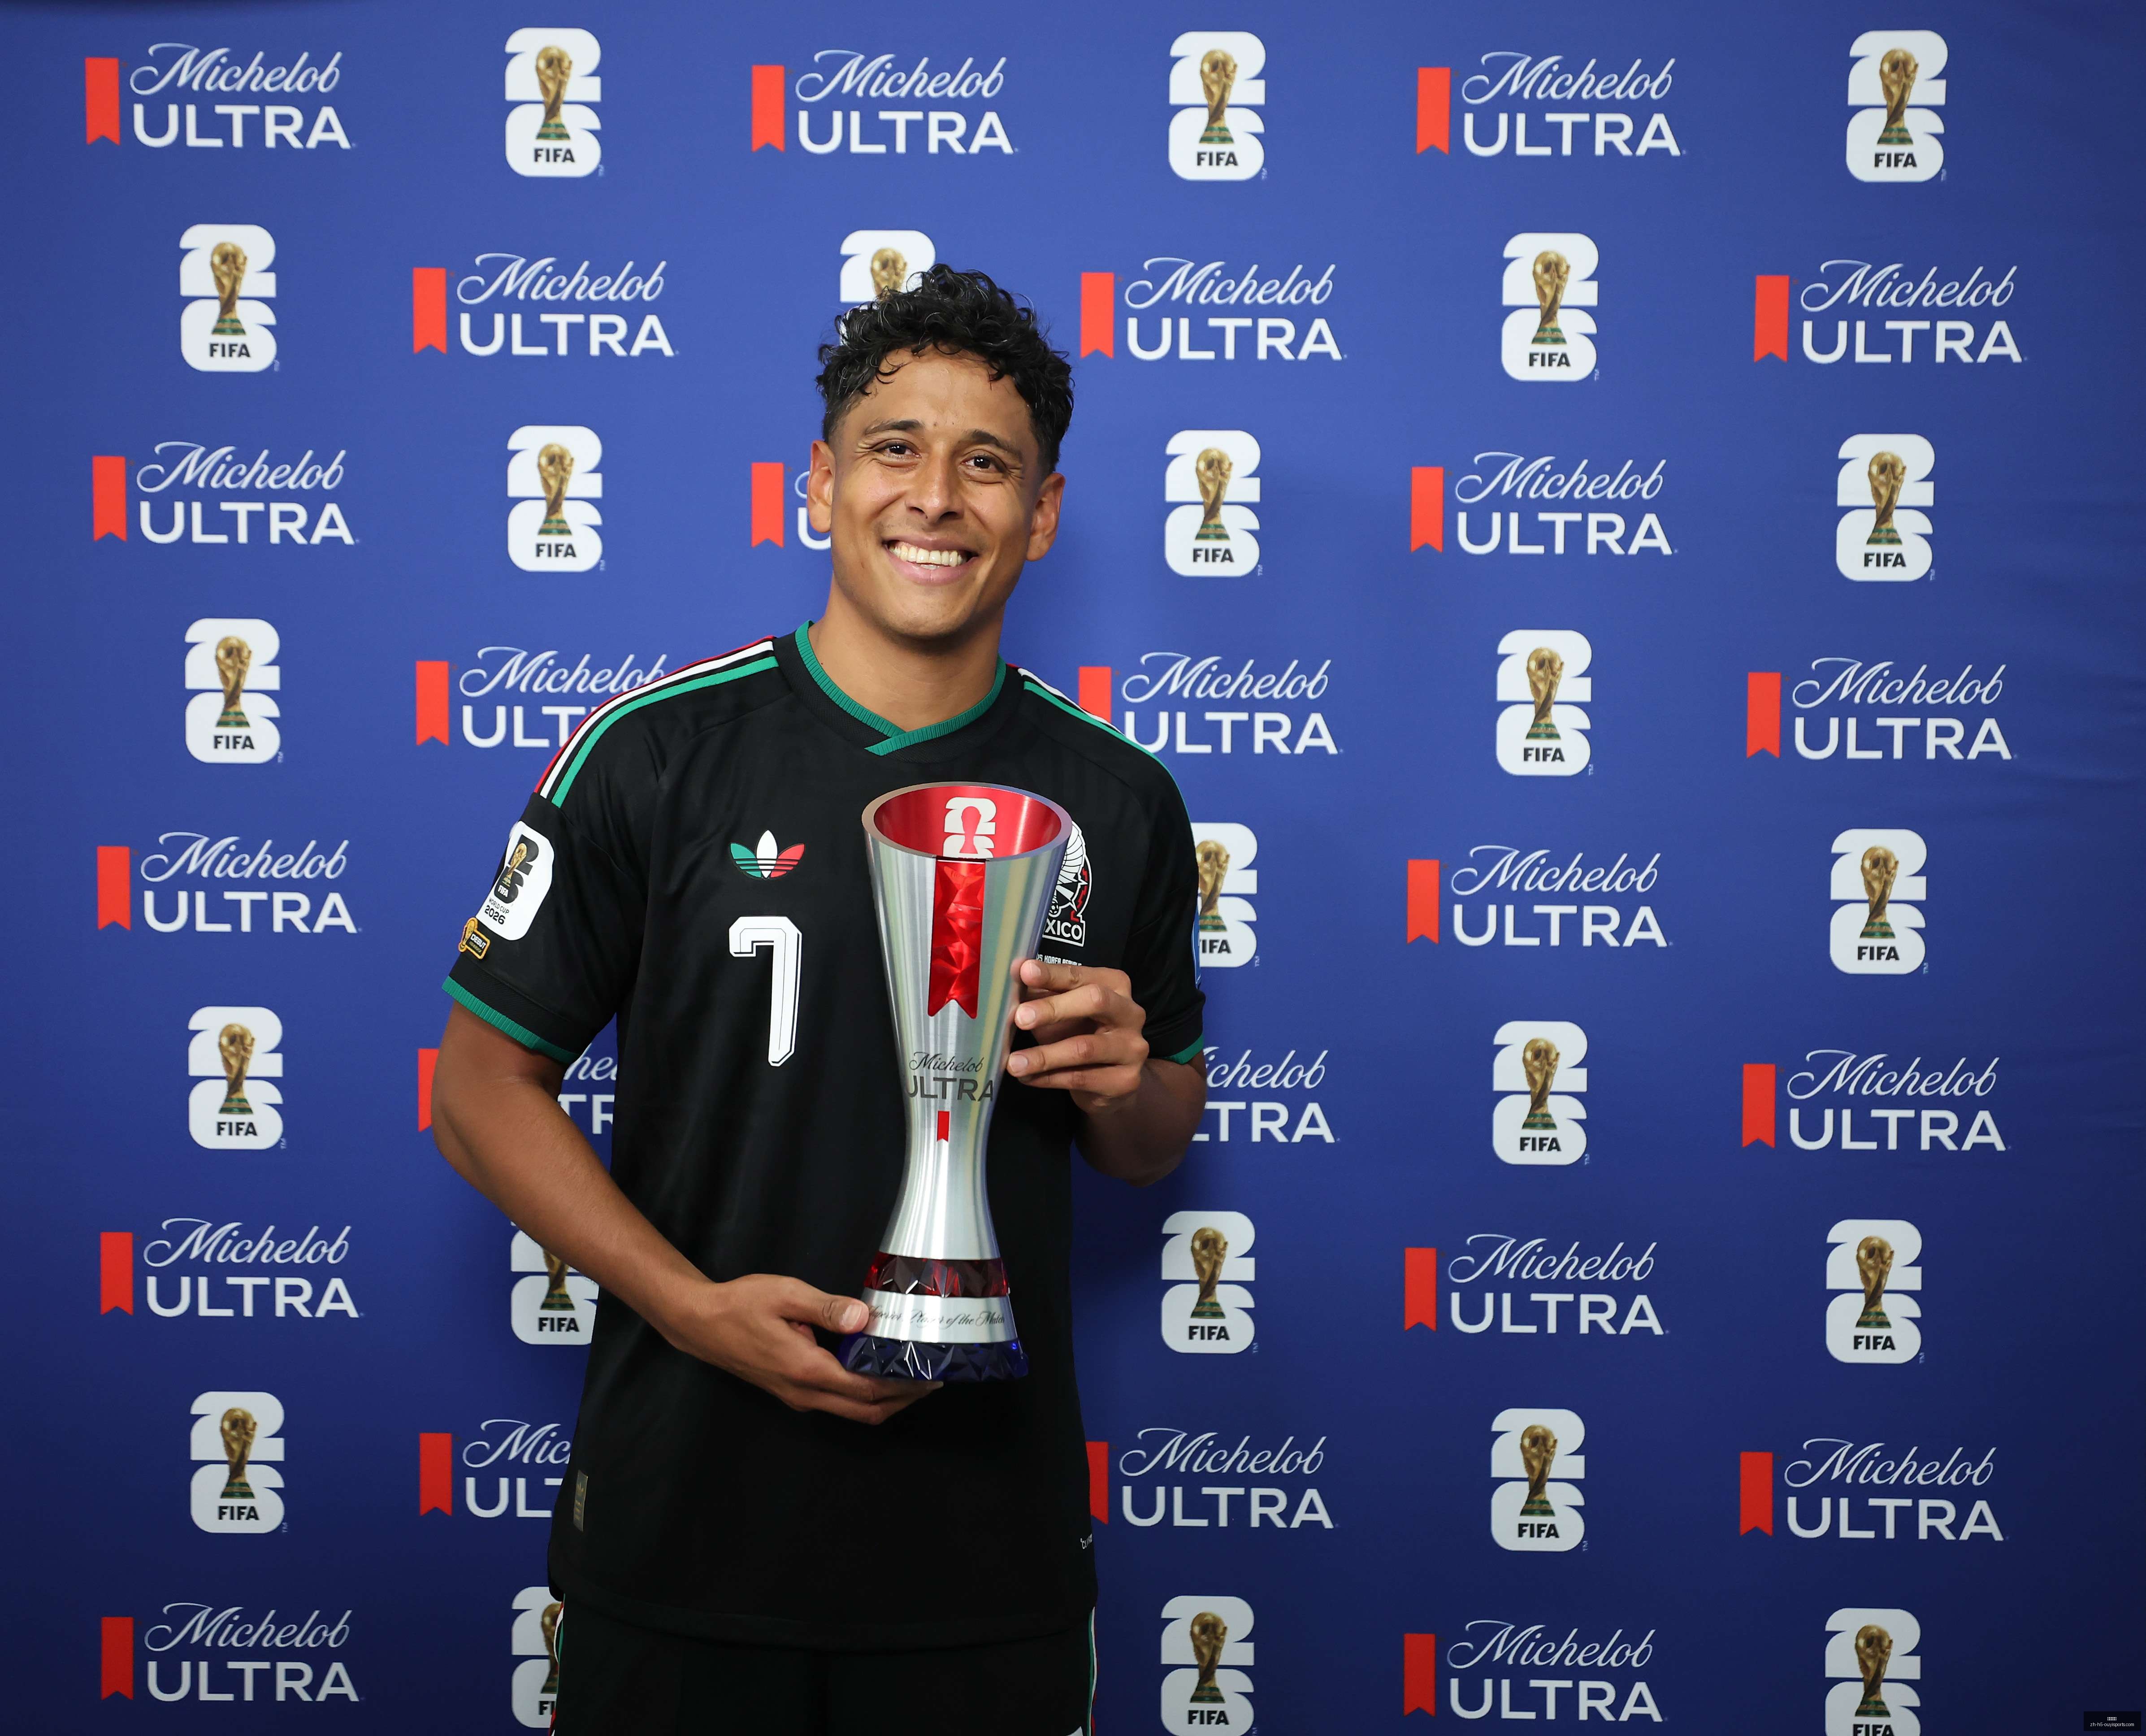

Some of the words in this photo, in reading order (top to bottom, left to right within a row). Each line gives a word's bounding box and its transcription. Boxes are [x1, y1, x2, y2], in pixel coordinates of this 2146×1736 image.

[130, 43, 342, 95] Michelob
[796, 50, 1006, 102] Michelob
[1462, 52, 1675, 104] Michelob
[134, 104, 351, 149] ULTRA
[798, 111, 1013, 154] ULTRA
[1464, 113, 1680, 156] ULTRA
[534, 148, 575, 162] FIFA
[1197, 152, 1238, 166] FIFA
[1874, 153, 1917, 167] FIFA
[457, 253, 667, 304] Michelob
[1125, 257, 1335, 309] Michelob
[1800, 260, 2017, 312] Michelob
[210, 343, 250, 357] FIFA
[460, 313, 674, 356] ULTRA
[1127, 317, 1342, 360] ULTRA
[1803, 321, 2022, 364] ULTRA
[1529, 353, 1570, 367] FIFA
[137, 442, 346, 492] Michelob
[1455, 452, 1666, 503] Michelob
[140, 501, 355, 545] ULTRA
[1457, 512, 1672, 555] ULTRA
[536, 543, 576, 557] FIFA
[1193, 548, 1234, 562] FIFA
[1864, 553, 1906, 567] FIFA
[1122, 652, 1331, 703] Michelob
[1792, 658, 2006, 708] Michelob
[214, 735, 254, 749] FIFA
[462, 705, 602, 748] ULT
[1124, 711, 1338, 755] ULTRA
[1795, 717, 2012, 760] ULTRA
[1524, 747, 1565, 762] FIFA
[141, 832, 349, 882] Michelob
[1451, 845, 1660, 895] Michelob
[144, 890, 357, 933] ULTRA
[498, 885, 509, 897] FIFA
[500, 906, 510, 914] CUP
[485, 905, 506, 924] 2026
[1045, 918, 1083, 940] XICO
[1453, 904, 1667, 947] ULTRA
[1199, 939, 1231, 954] IFA
[1858, 946, 1899, 960] FIFA
[729, 916, 802, 1067] 7
[909, 1052, 984, 1072] Michelob
[1203, 1047, 1328, 1089] chelob
[1787, 1050, 1999, 1099] Michelob
[906, 1075, 993, 1102] ULTRA
[217, 1122, 257, 1136] FIFA
[1192, 1102, 1335, 1143] TRA
[1520, 1137, 1561, 1151] FIFA
[1790, 1108, 2006, 1151] ULTRA
[143, 1218, 351, 1267] Michelob
[1448, 1234, 1657, 1283] Michelob
[147, 1276, 359, 1318] ULTRA
[1451, 1292, 1664, 1335] ULTRA
[538, 1317, 580, 1332] FIFA
[943, 1314, 961, 1329] of
[958, 1314, 974, 1325] the
[1189, 1327, 1230, 1340] FIFA
[1854, 1335, 1895, 1350] FIFA
[1119, 1428, 1327, 1476] Michelob
[1784, 1438, 1996, 1487] Michelob
[218, 1507, 259, 1520] FIFA
[1123, 1486, 1334, 1528] ULTRA
[1787, 1497, 2003, 1541] ULTRA
[1518, 1524, 1559, 1538] FIFA
[145, 1602, 352, 1651] Michelob
[1447, 1620, 1656, 1669] Michelob
[147, 1661, 359, 1701] ULTRA
[1450, 1678, 1663, 1722] ULTRA
[1188, 1711, 1229, 1725] FIFA
[1853, 1724, 1894, 1736] FIFA
